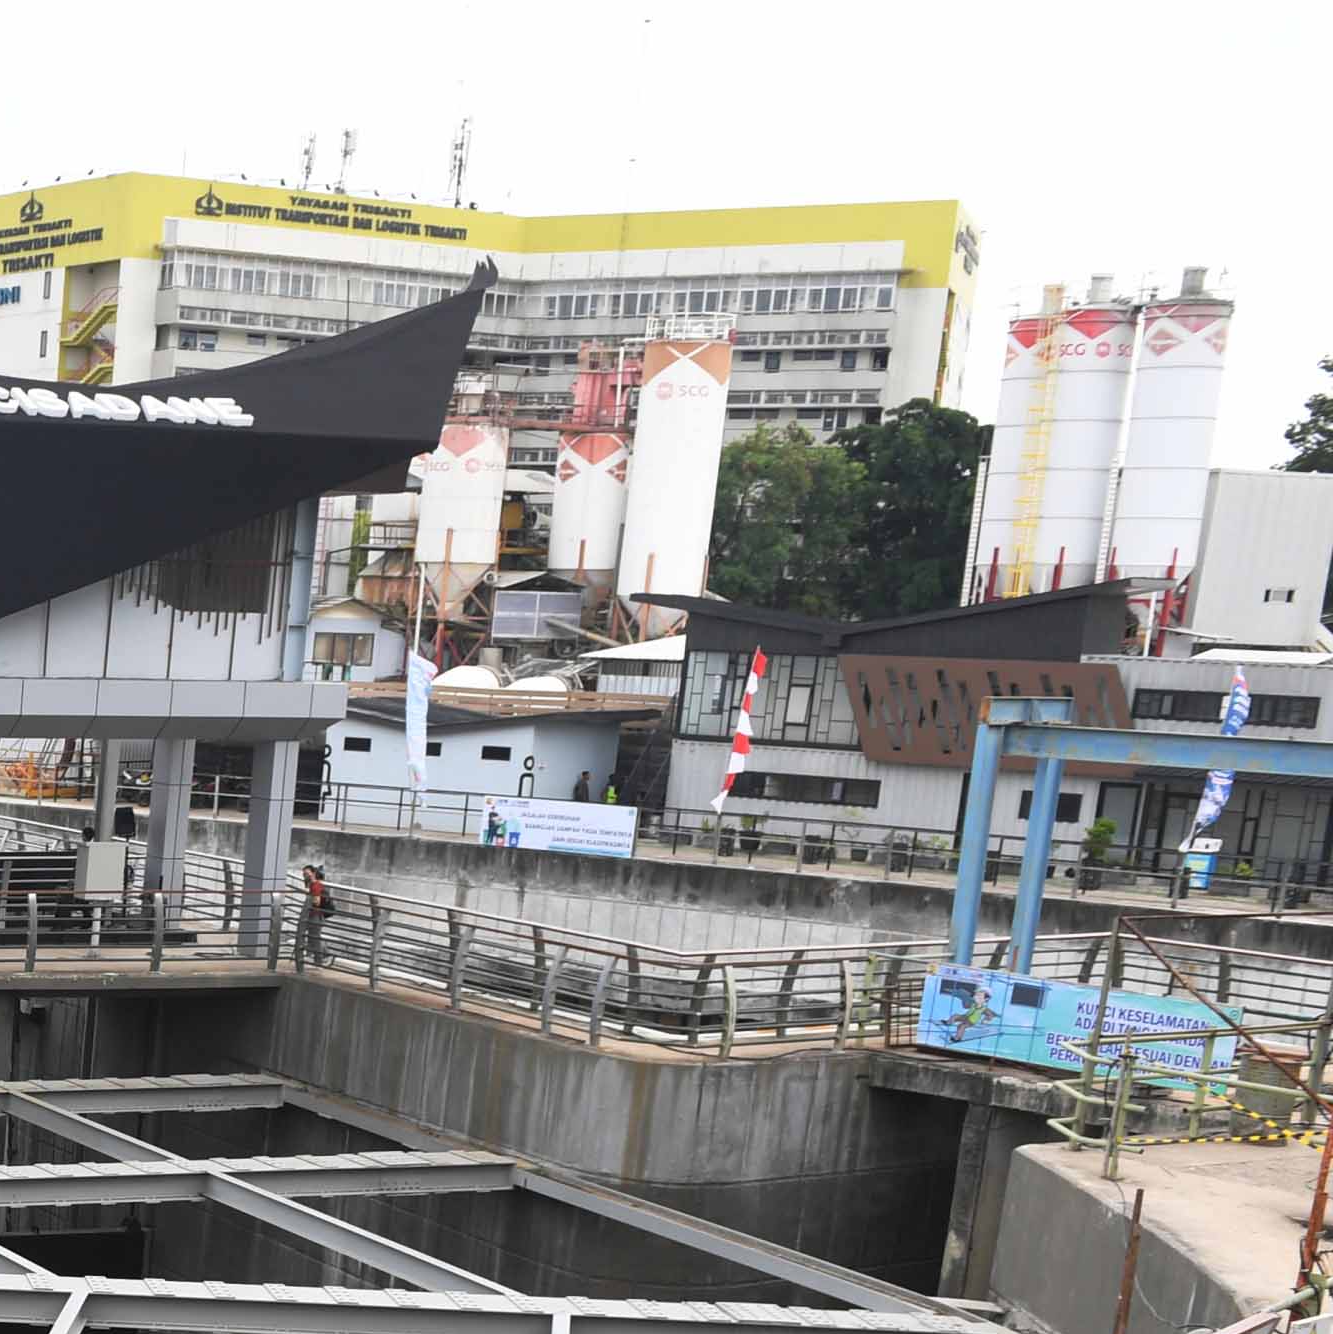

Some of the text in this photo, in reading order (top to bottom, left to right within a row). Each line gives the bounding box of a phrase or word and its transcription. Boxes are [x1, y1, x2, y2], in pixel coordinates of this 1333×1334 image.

[225, 202, 272, 220] INSTITUT
[1, 253, 55, 273] TRISAKTI
[678, 384, 710, 398] SCG
[1102, 1021, 1115, 1033] DI
